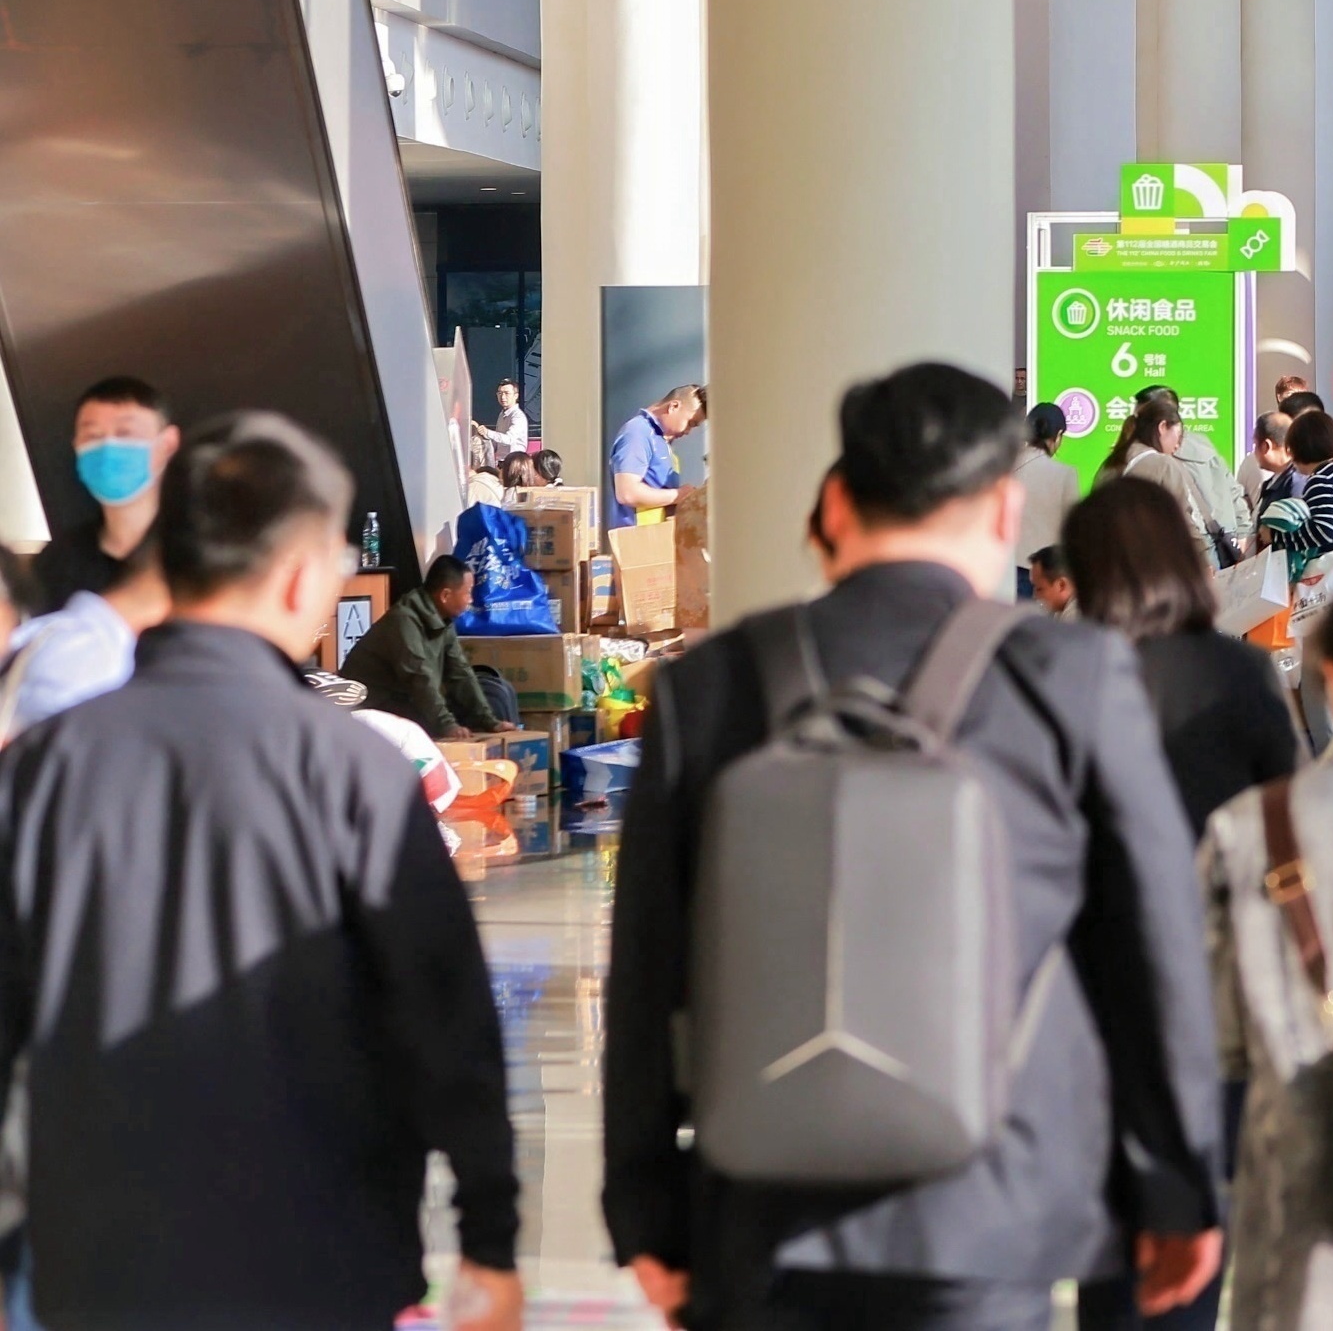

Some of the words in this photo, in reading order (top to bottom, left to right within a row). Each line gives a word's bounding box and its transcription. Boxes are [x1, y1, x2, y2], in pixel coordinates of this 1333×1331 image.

[1106, 298, 1197, 323] 休闲食品
[1106, 325, 1146, 336] SNACK
[1148, 325, 1180, 336] FOOD
[1110, 341, 1139, 378] 6
[1143, 353, 1166, 366] 号馆
[1144, 367, 1166, 378] Hall
[1192, 424, 1214, 433] AREA
